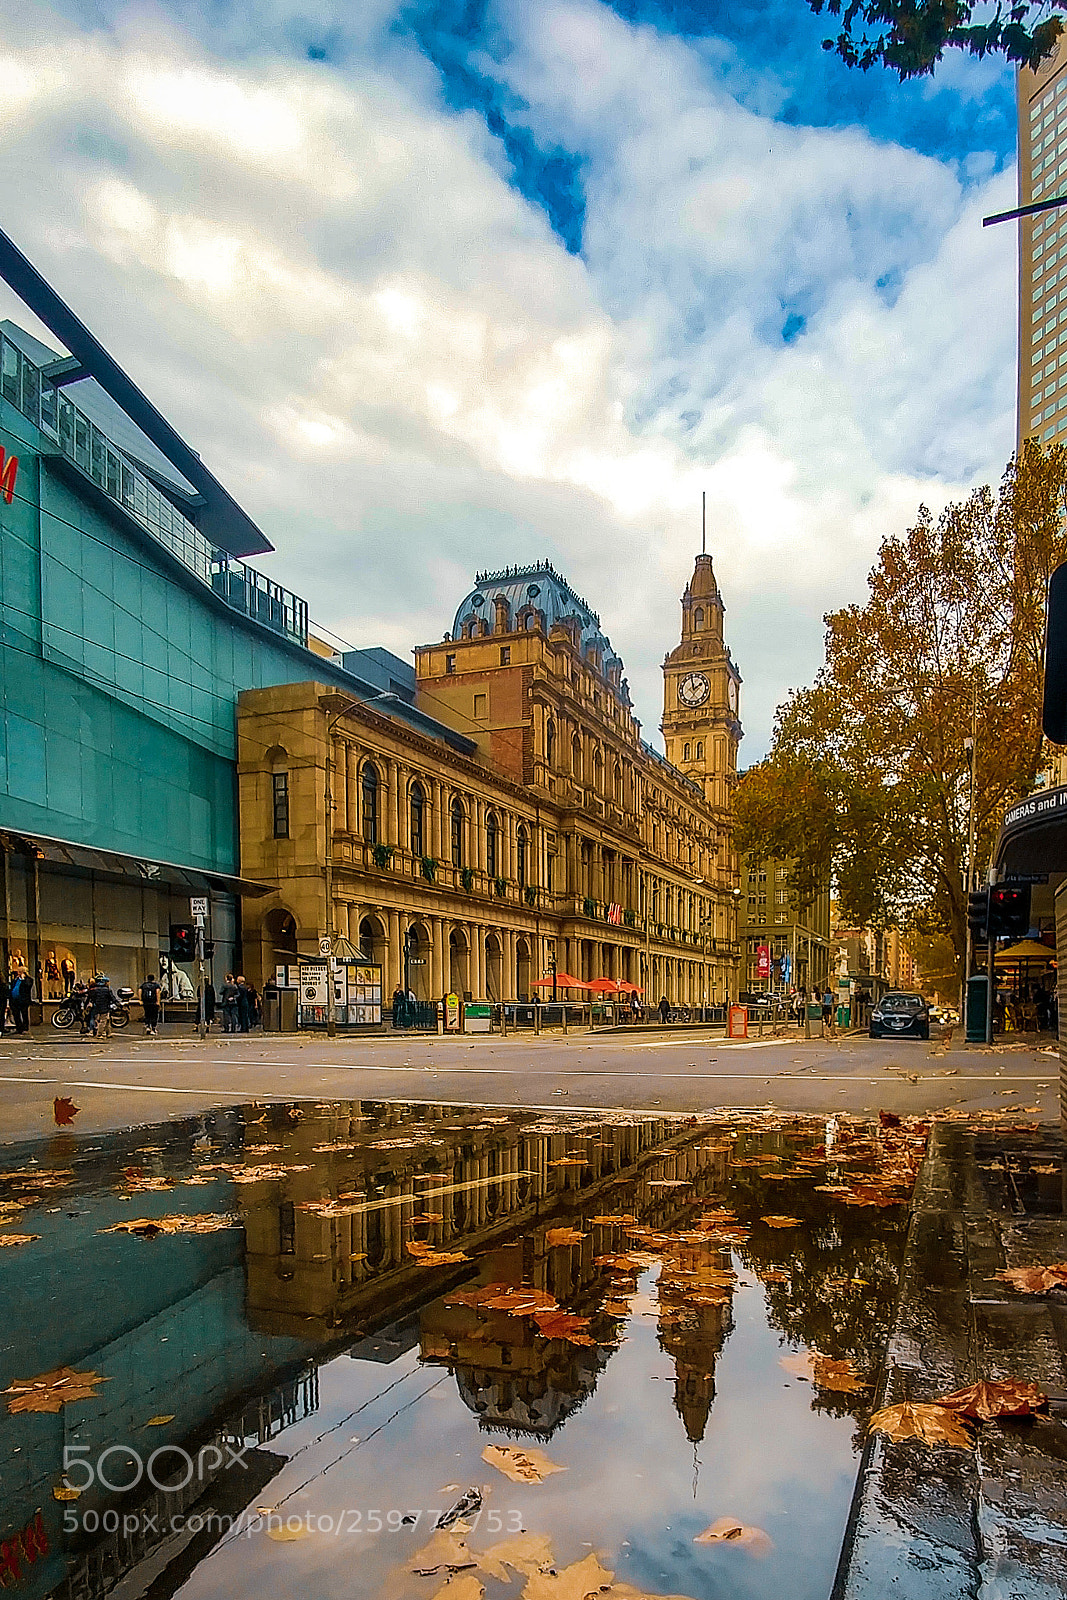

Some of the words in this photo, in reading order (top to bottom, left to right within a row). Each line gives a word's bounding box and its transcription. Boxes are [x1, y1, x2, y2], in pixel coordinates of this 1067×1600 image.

[1005, 802, 1036, 826] CAMERAS
[1037, 795, 1057, 811] and
[321, 942, 330, 950] 40
